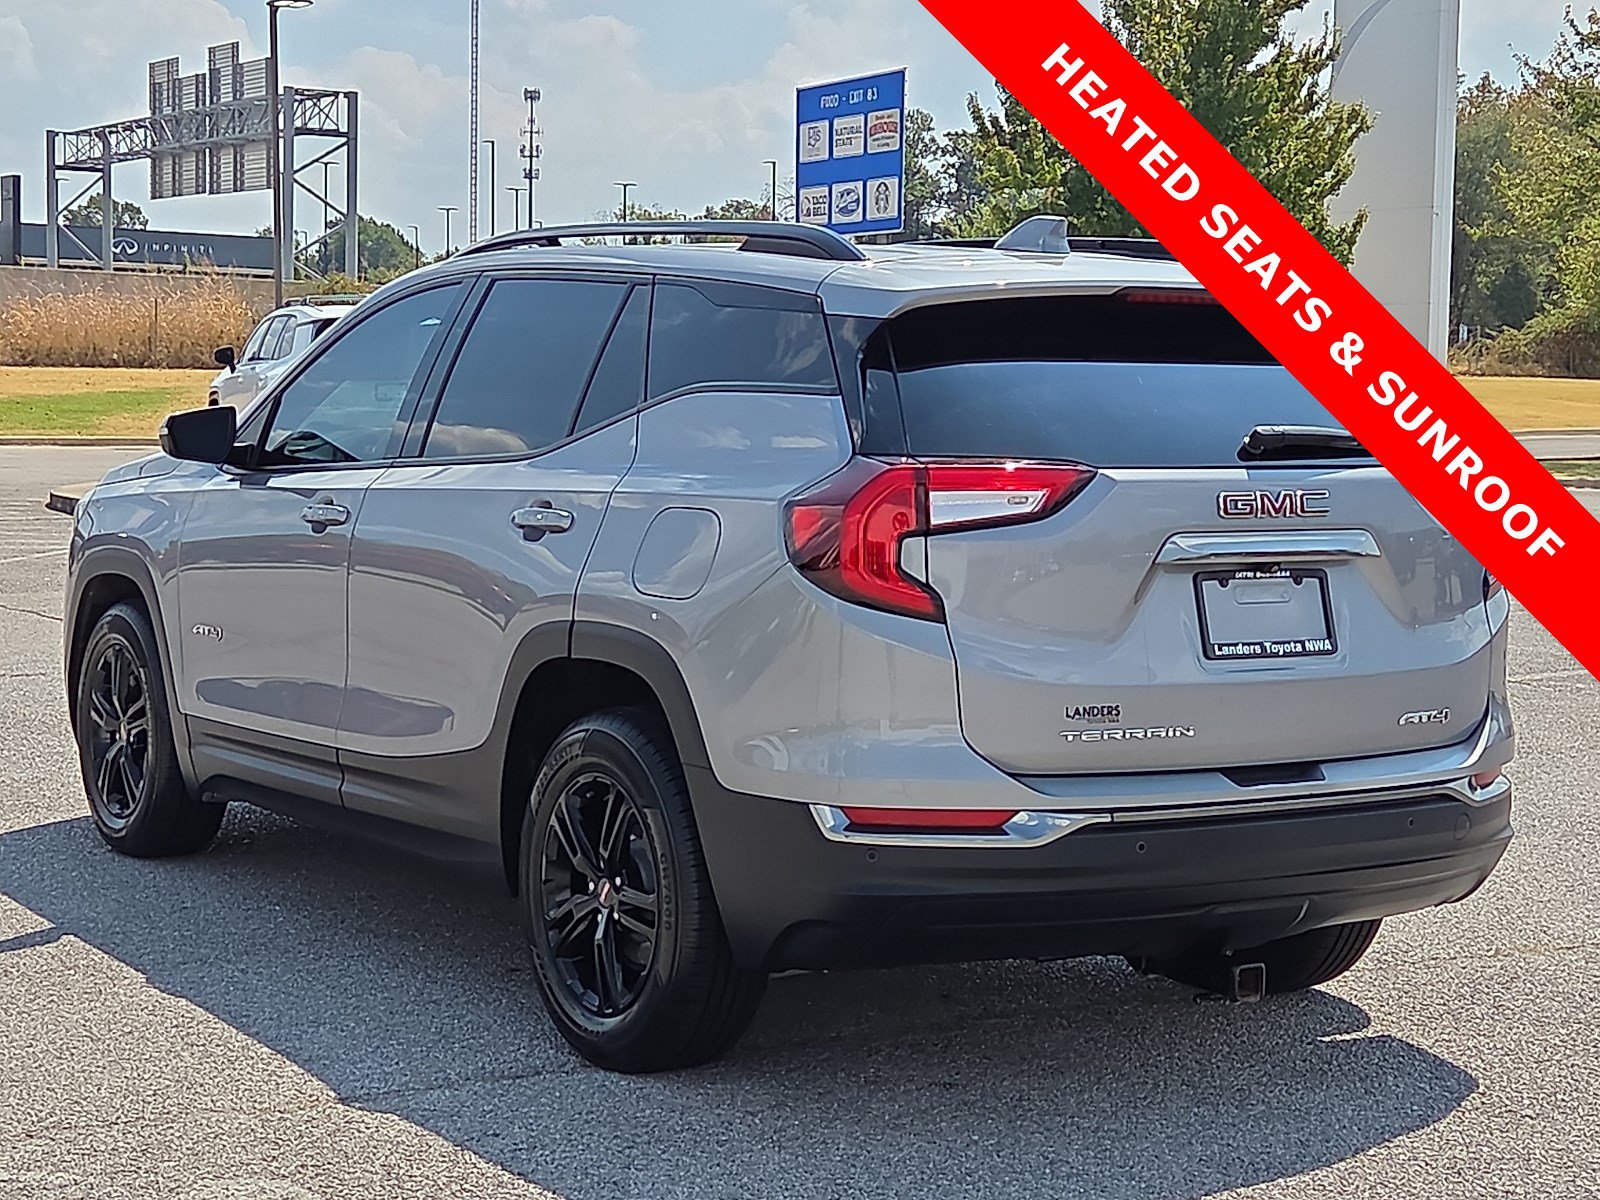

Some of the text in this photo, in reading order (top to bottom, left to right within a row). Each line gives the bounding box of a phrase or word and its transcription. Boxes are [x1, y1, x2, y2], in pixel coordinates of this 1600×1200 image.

[820, 94, 840, 109] FOOD
[849, 89, 864, 104] EXIT
[866, 87, 878, 101] 83
[812, 195, 827, 206] TACO
[812, 206, 827, 217] BELL
[144, 243, 214, 254] INFINITI
[1217, 489, 1331, 519] GMC
[191, 623, 223, 641] AT4
[1214, 639, 1332, 656] Landers Toyota NWA
[1065, 704, 1120, 720] LANDERS
[1398, 707, 1450, 725] AT4
[1060, 726, 1196, 742] TERRAIN
